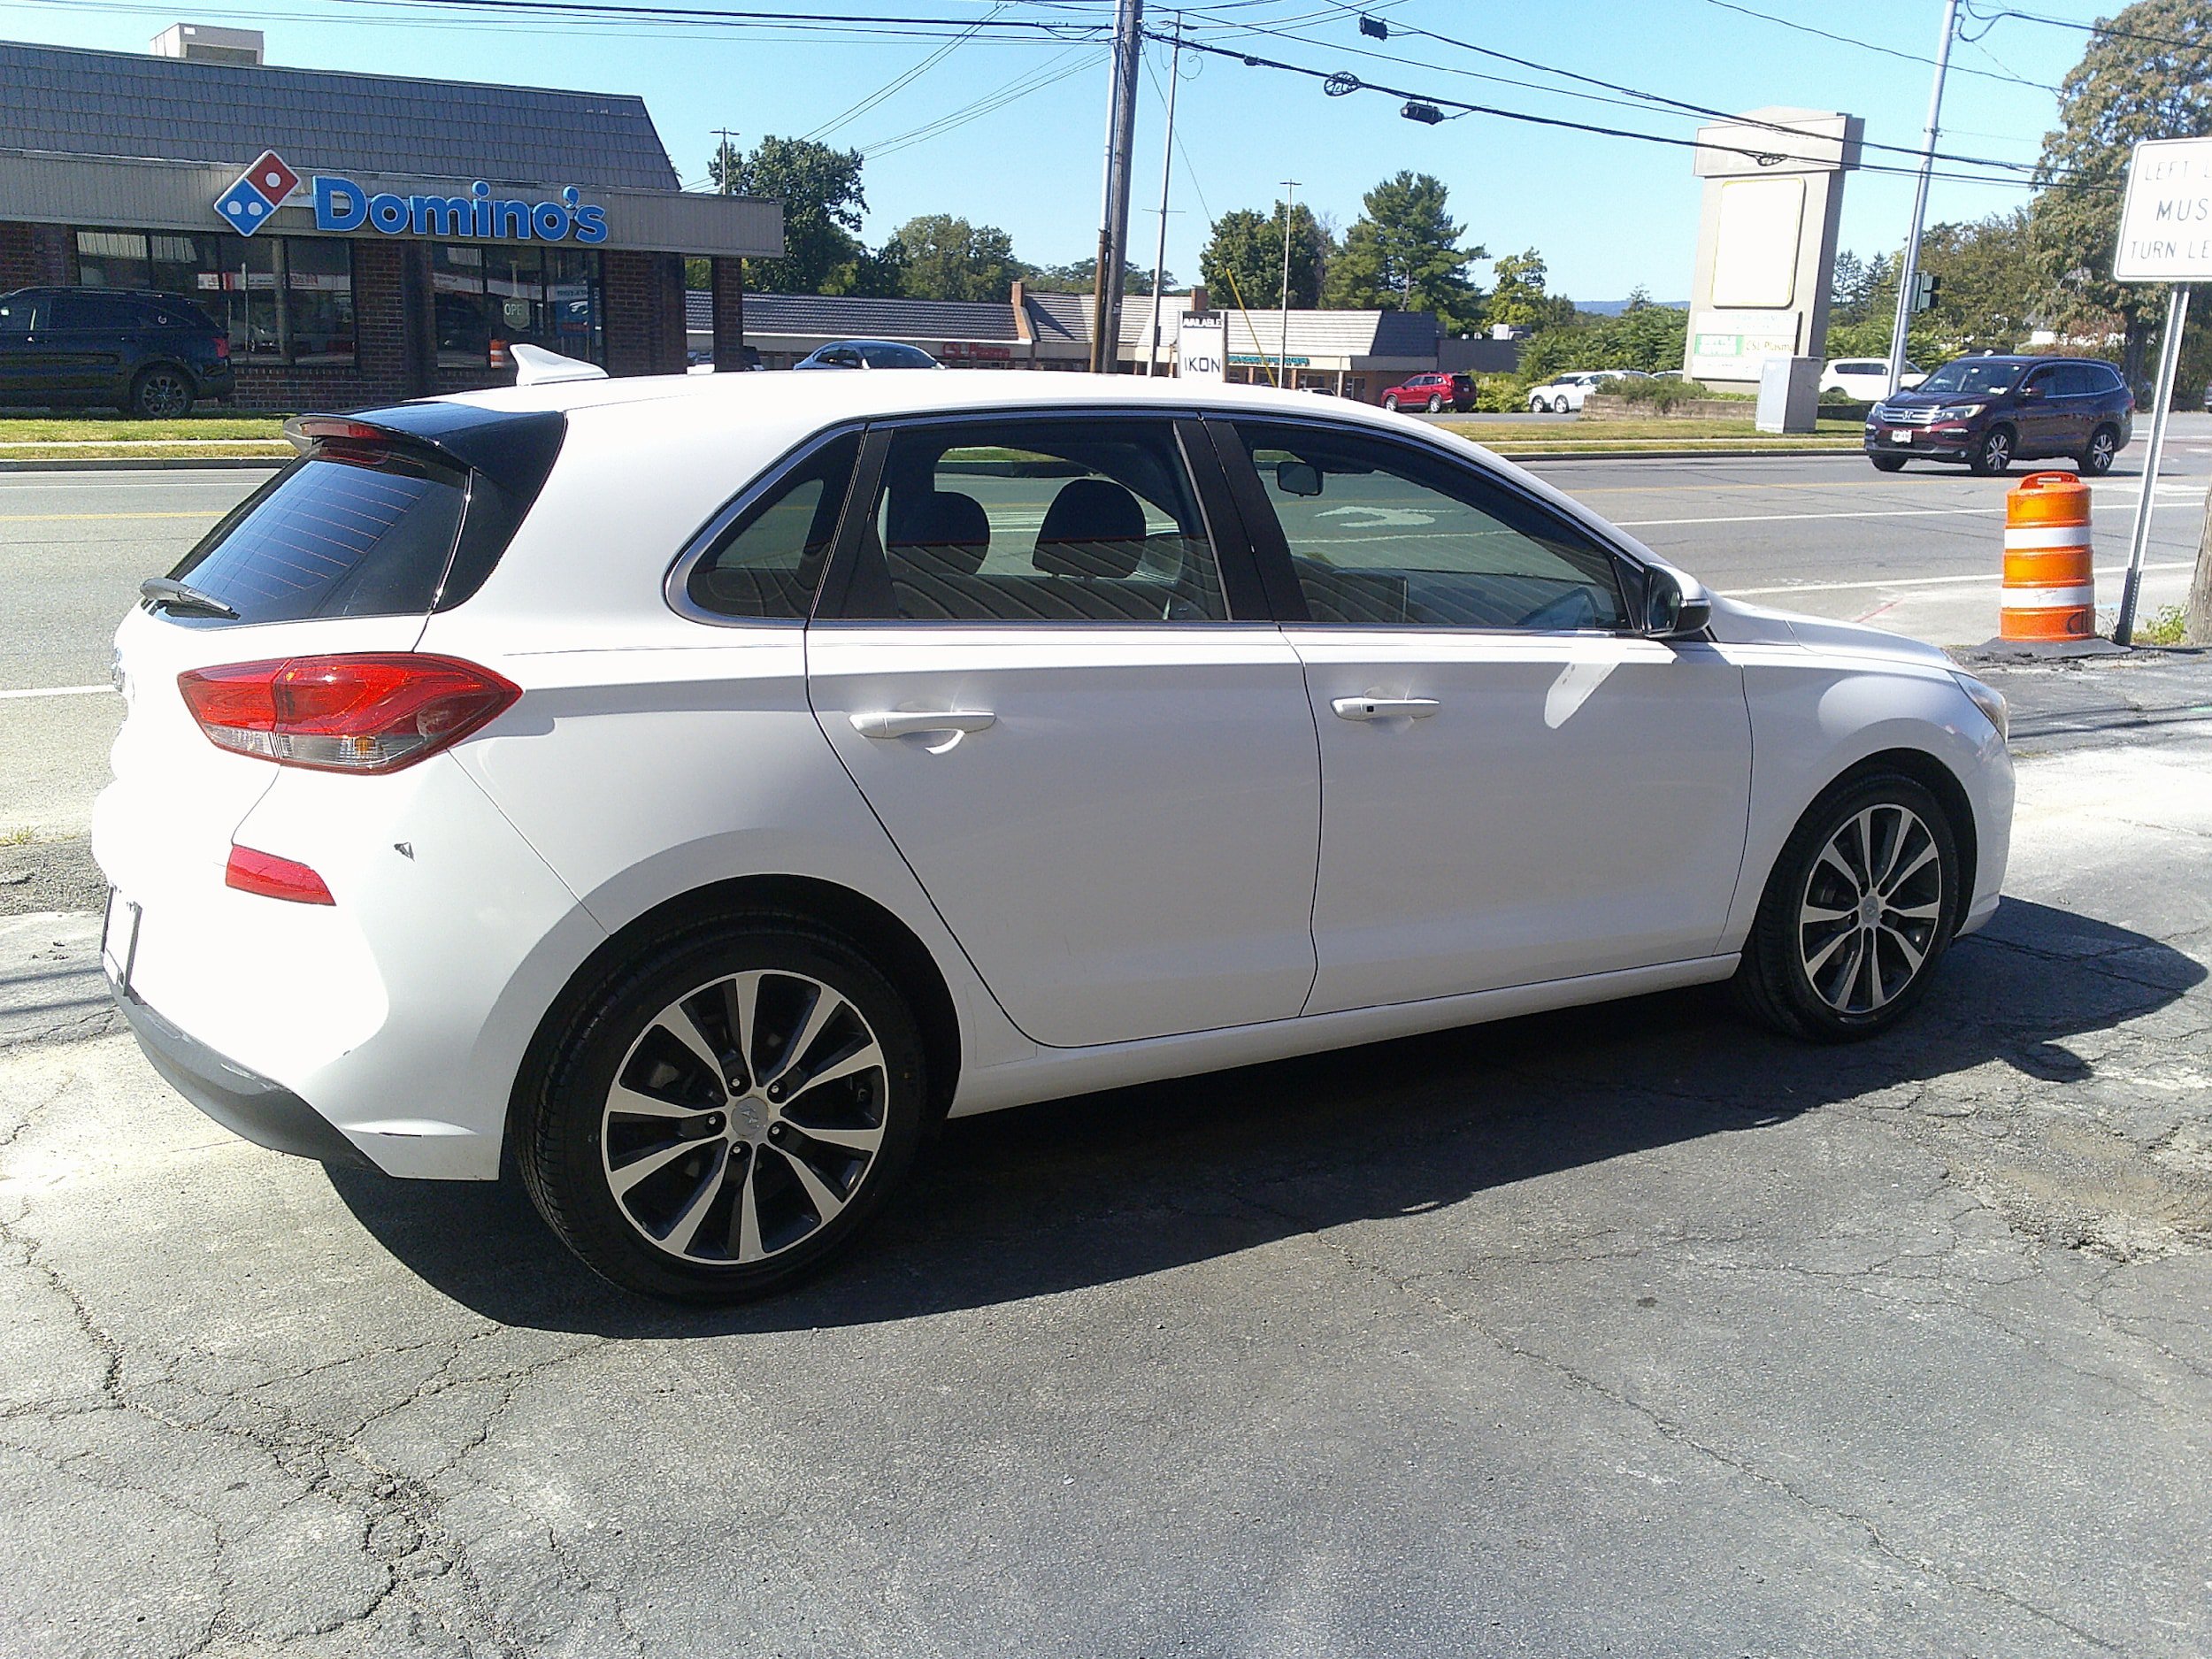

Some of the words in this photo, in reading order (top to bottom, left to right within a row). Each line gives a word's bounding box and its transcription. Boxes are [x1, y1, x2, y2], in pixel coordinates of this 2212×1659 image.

[2145, 160, 2188, 180] LEFT
[312, 175, 609, 244] Domino's
[2155, 197, 2208, 221] MUS
[2131, 241, 2177, 259] TURN
[504, 303, 528, 316] OPE
[1182, 318, 1222, 327] AVAILABLE
[1184, 357, 1221, 373] IKON
